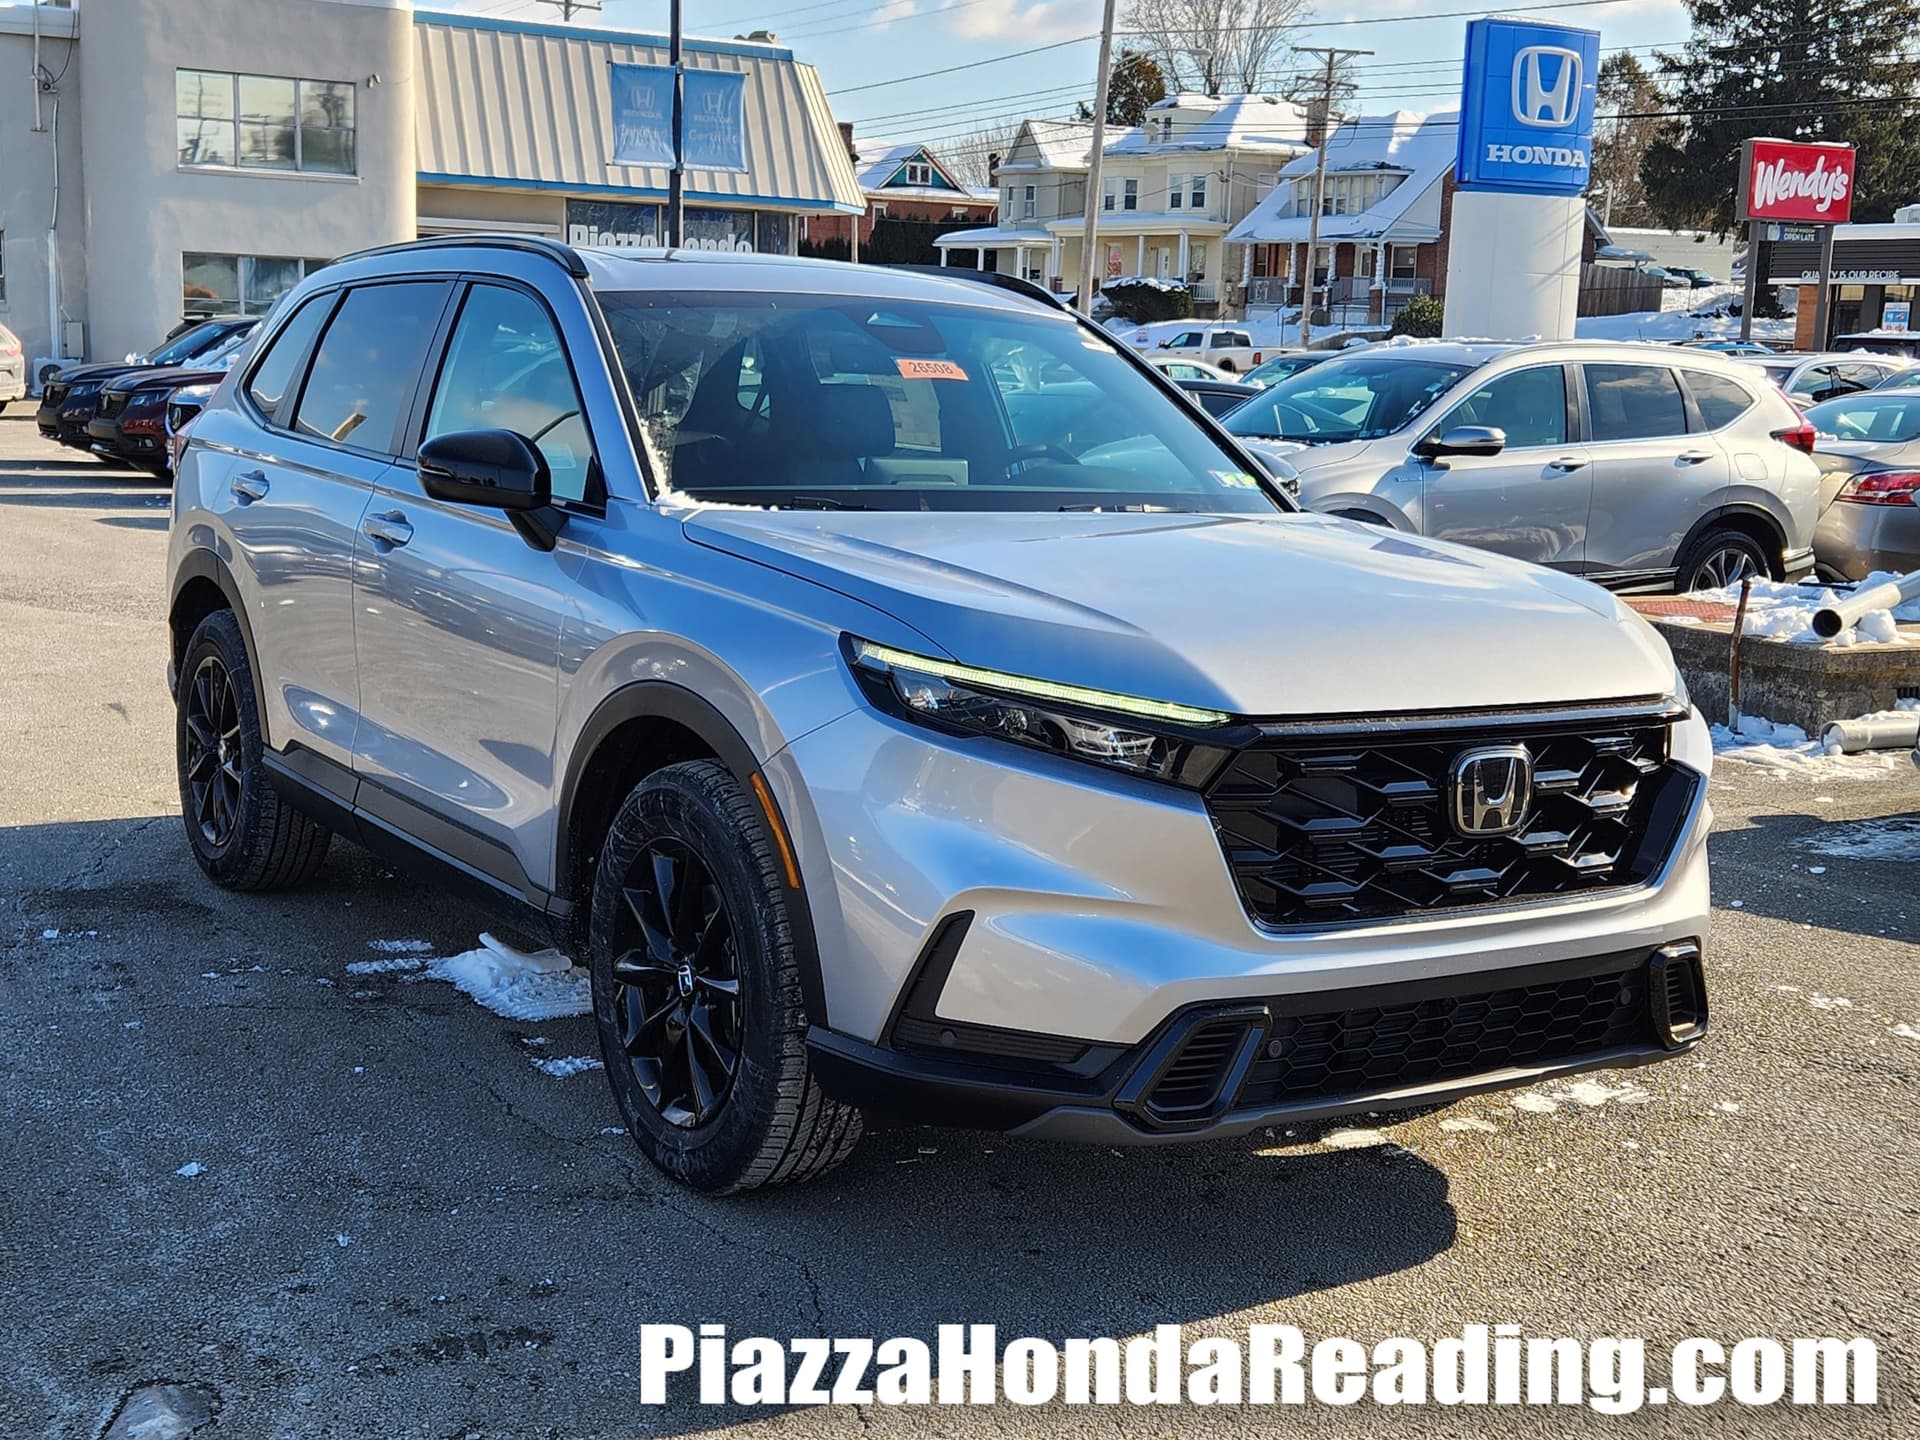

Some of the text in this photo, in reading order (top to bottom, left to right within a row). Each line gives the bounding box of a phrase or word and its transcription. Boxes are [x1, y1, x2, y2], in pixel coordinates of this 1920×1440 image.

[1486, 144, 1588, 169] HONDA
[1753, 155, 1849, 213] Wendy's
[1784, 233, 1815, 242] OPEN LATE
[1848, 270, 1869, 280] OUR
[1869, 270, 1900, 280] RECIPE
[908, 361, 954, 375] 26508
